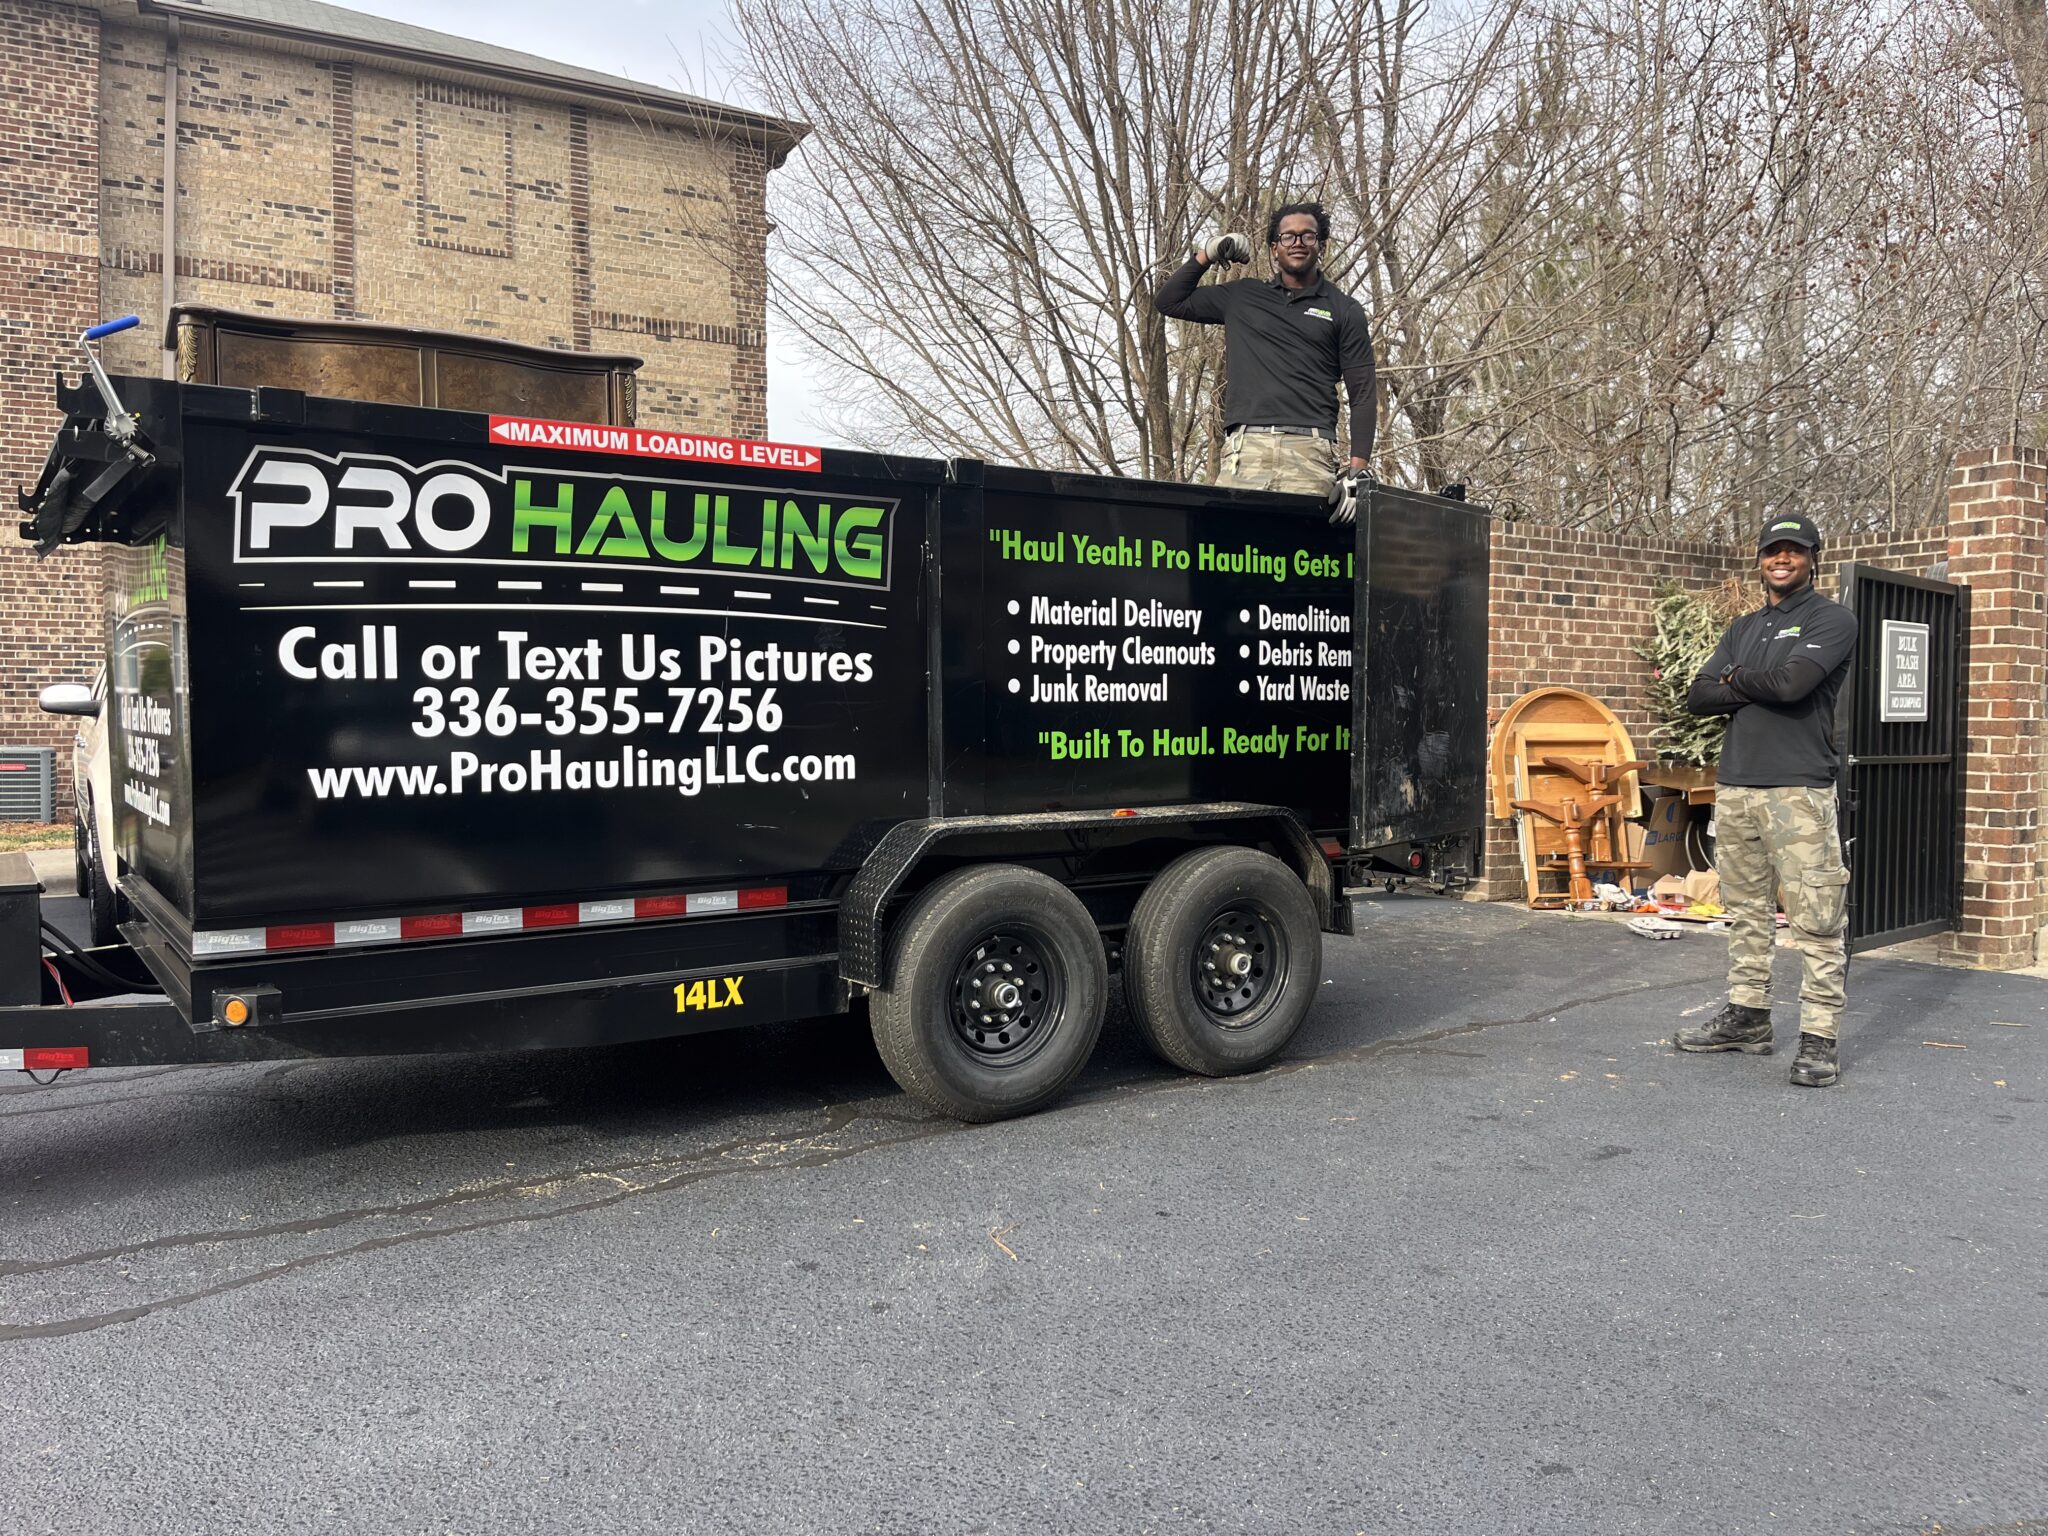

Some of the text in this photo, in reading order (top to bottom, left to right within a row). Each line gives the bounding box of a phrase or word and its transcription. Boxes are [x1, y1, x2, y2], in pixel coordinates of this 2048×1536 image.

[510, 422, 804, 467] MAXIMUM LOADING LEVEL
[250, 460, 885, 579] PRO HAULING
[989, 529, 1355, 582] "Haul Yeah! Pro Hauling Gets I
[1030, 596, 1202, 635] Material Delivery
[1258, 604, 1350, 634] Demolition
[279, 624, 873, 683] Call or Text Us Pictures
[1031, 635, 1216, 671] Property Cleanouts
[1258, 640, 1313, 667] Debris
[1896, 654, 1920, 670] TRASH
[1030, 672, 1168, 703] Junk Removal
[1257, 674, 1350, 701] Yard Waste
[1897, 673, 1917, 689] AREA
[411, 687, 783, 738] 336-355-7256
[1039, 729, 1110, 760] "Built
[1118, 730, 1144, 758] To
[1153, 727, 1214, 757] Haul.
[1223, 727, 1289, 759] Ready
[1296, 726, 1329, 752] For
[307, 745, 856, 796] www.ProHaulingLLC.com
[674, 976, 744, 1013] 14LX
